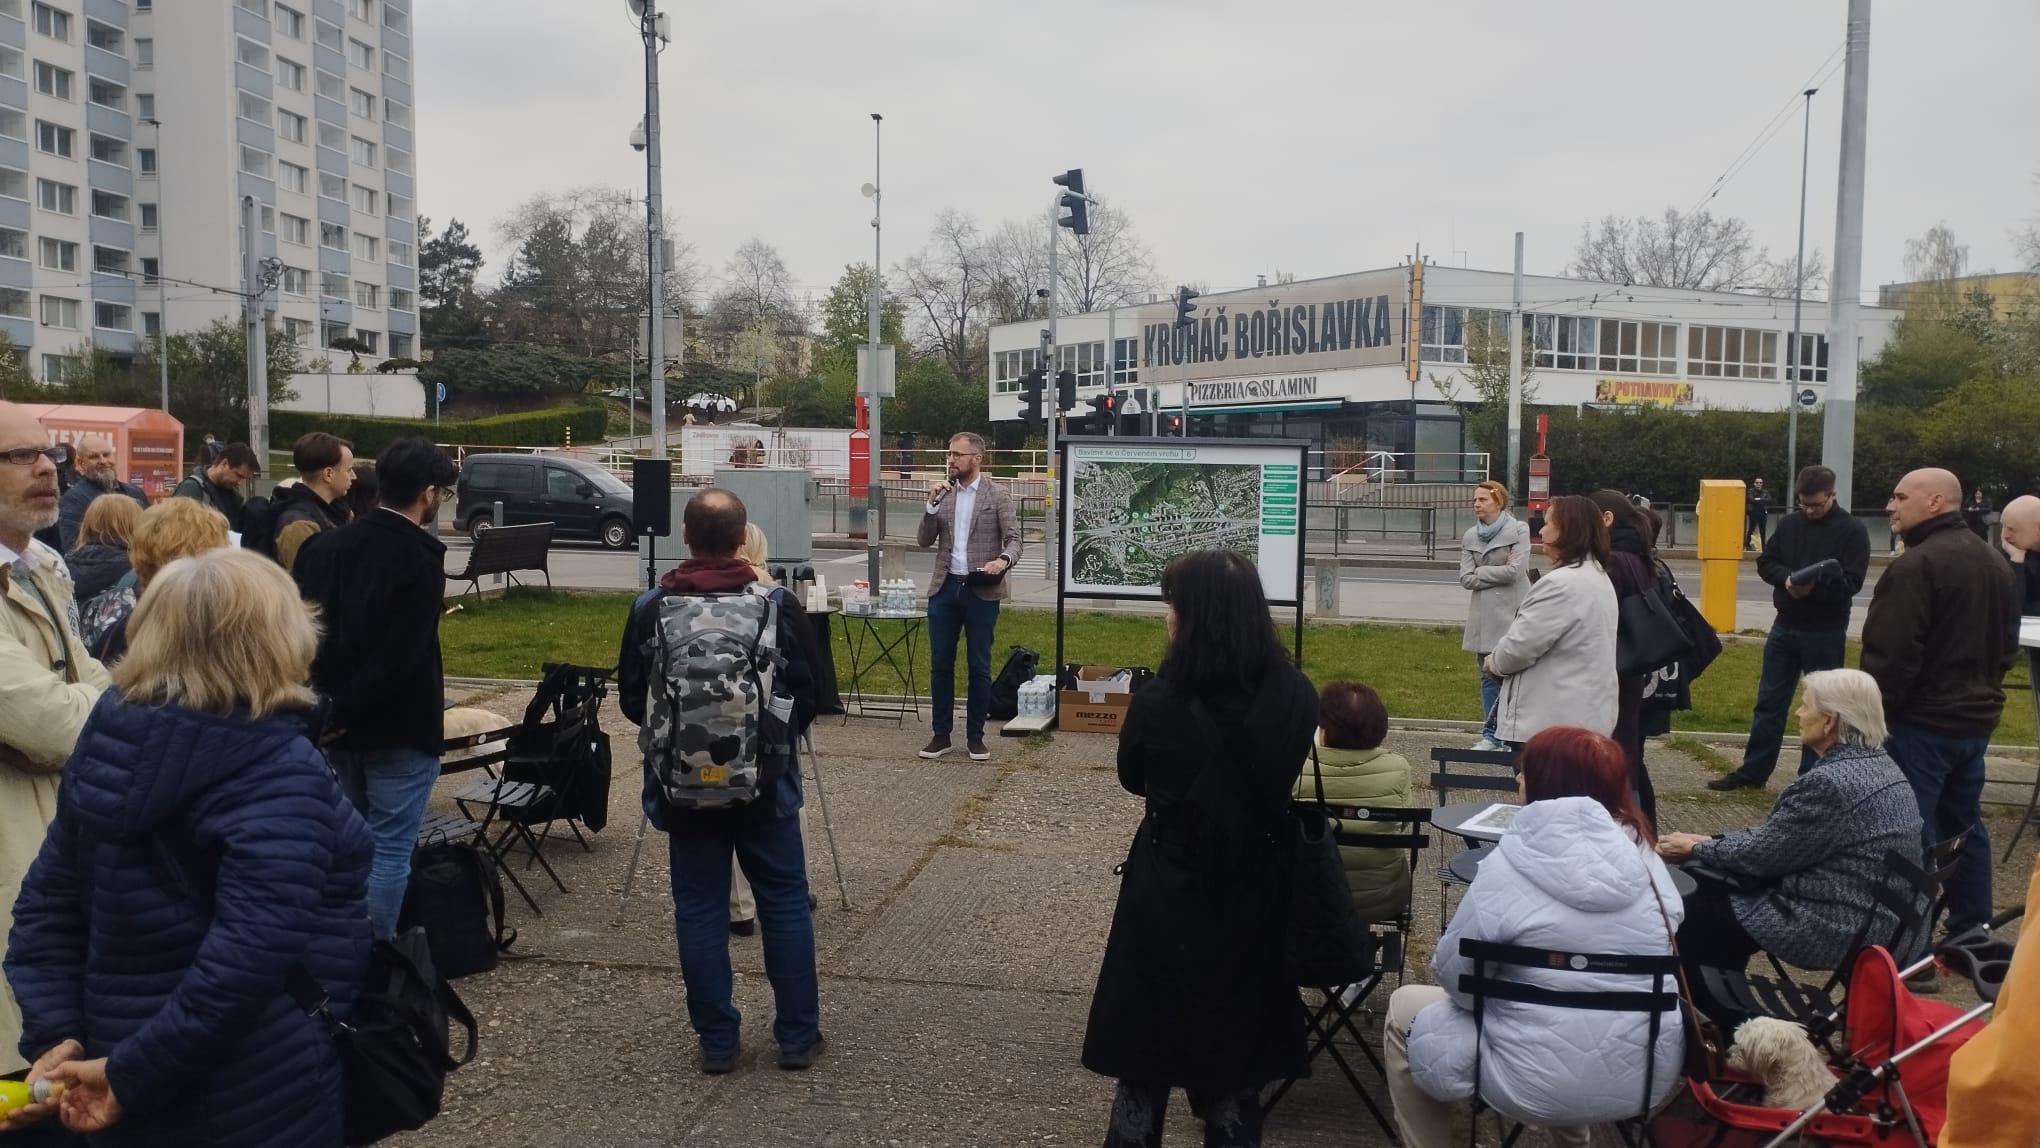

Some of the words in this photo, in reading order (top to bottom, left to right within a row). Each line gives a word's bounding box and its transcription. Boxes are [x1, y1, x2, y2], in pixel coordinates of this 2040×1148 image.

[1234, 295, 1392, 360] BOŘISLAVKA
[1190, 381, 1245, 401] PIZZERIA
[1262, 376, 1317, 398] SLAMINI
[1615, 381, 1679, 398] POTRAVINY
[47, 429, 116, 453] TEXL
[1121, 449, 1157, 457] Červeném
[1076, 711, 1117, 719] mezzo
